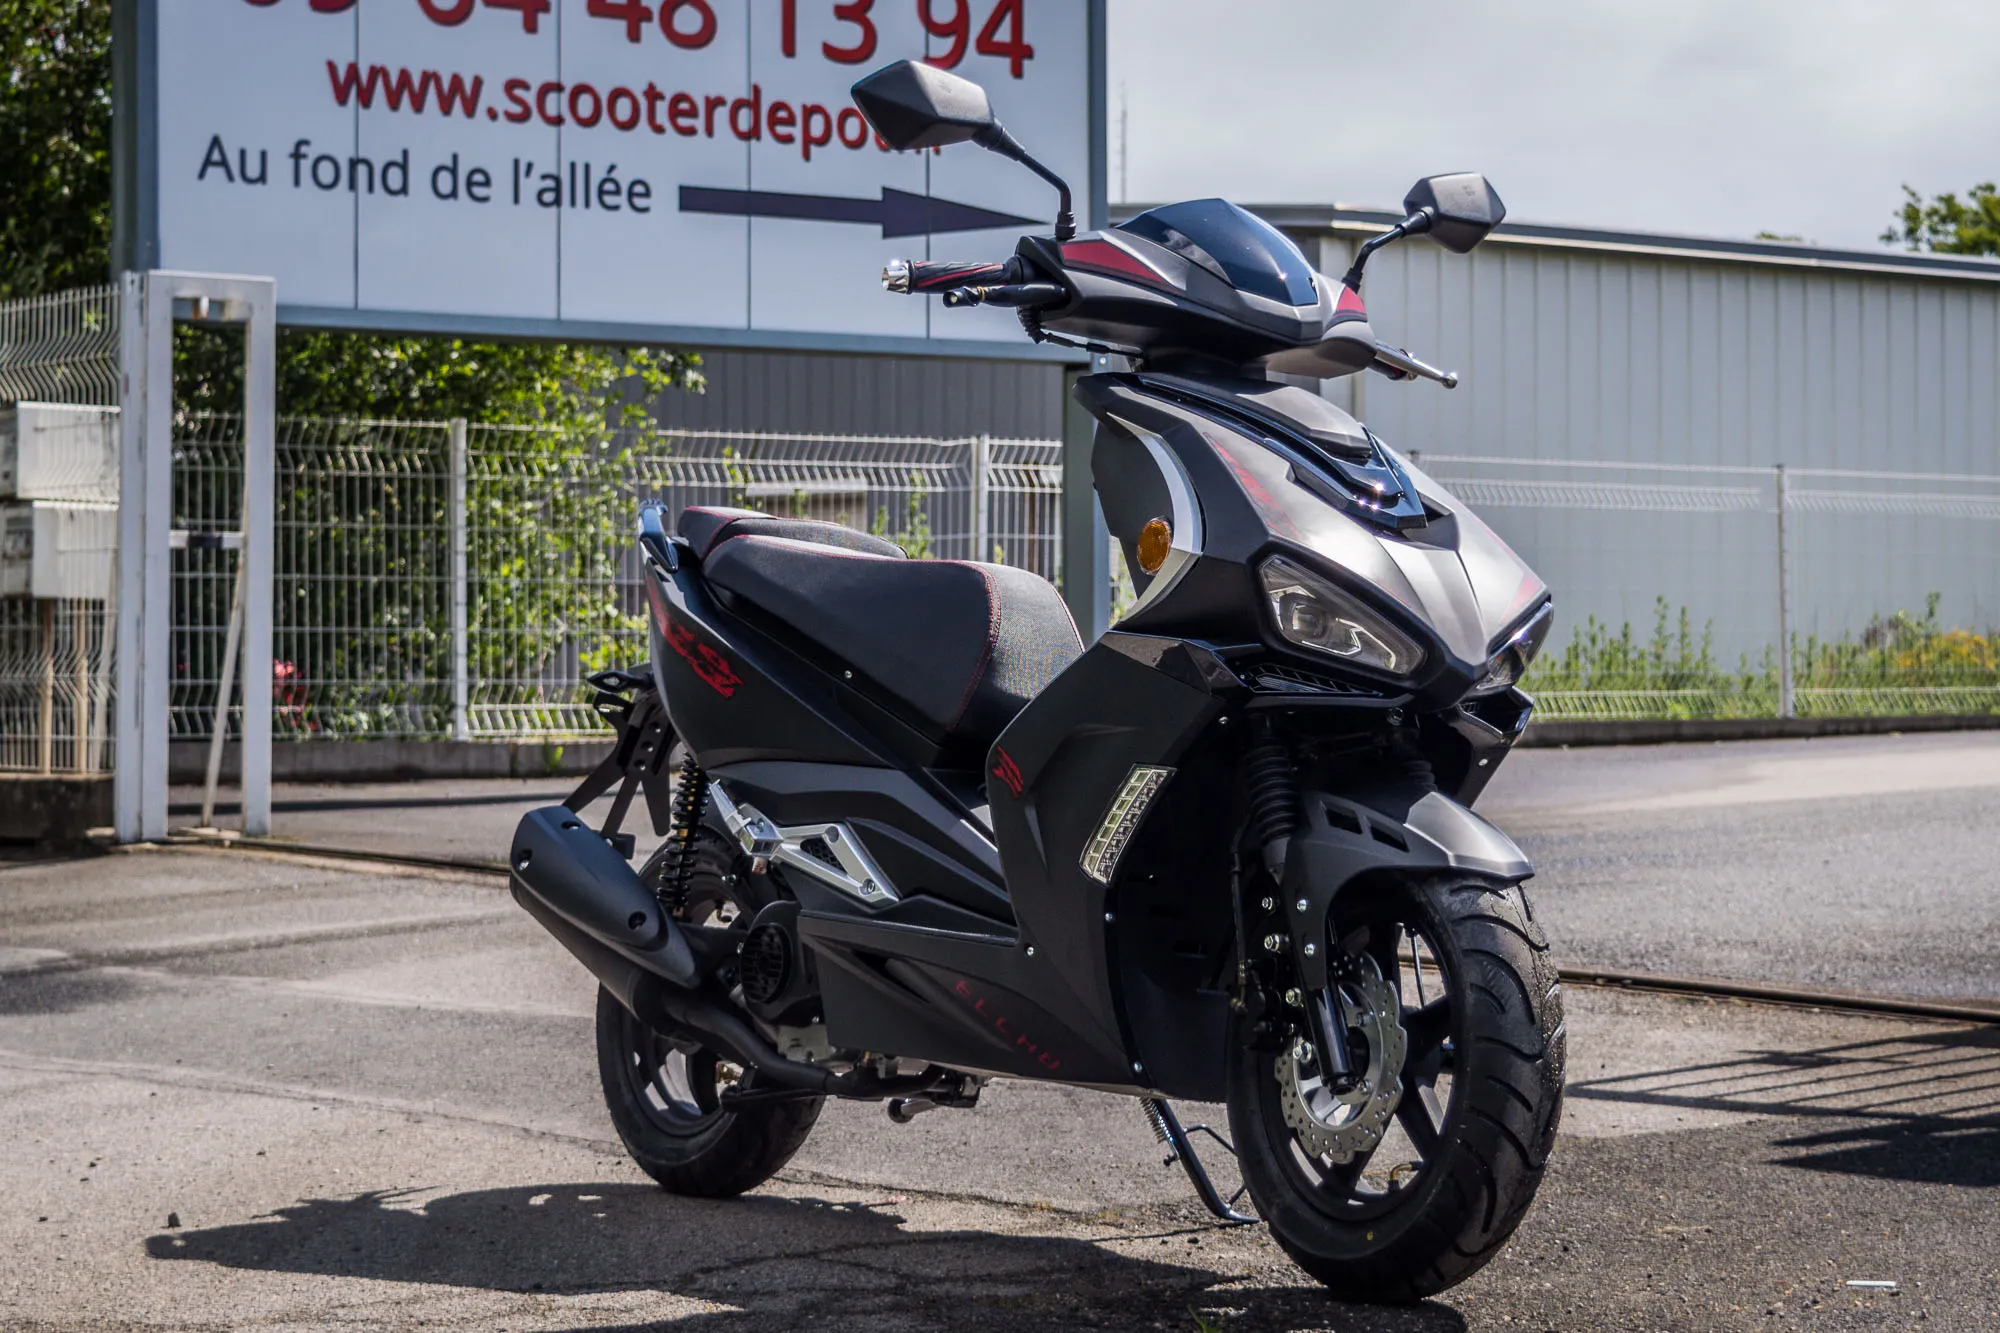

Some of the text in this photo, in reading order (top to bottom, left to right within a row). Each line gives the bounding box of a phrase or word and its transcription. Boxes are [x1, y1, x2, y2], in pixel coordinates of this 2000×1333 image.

[916, 0, 1034, 79] 94
[196, 133, 269, 186] Au
[288, 138, 411, 197] fond
[430, 152, 493, 203] de
